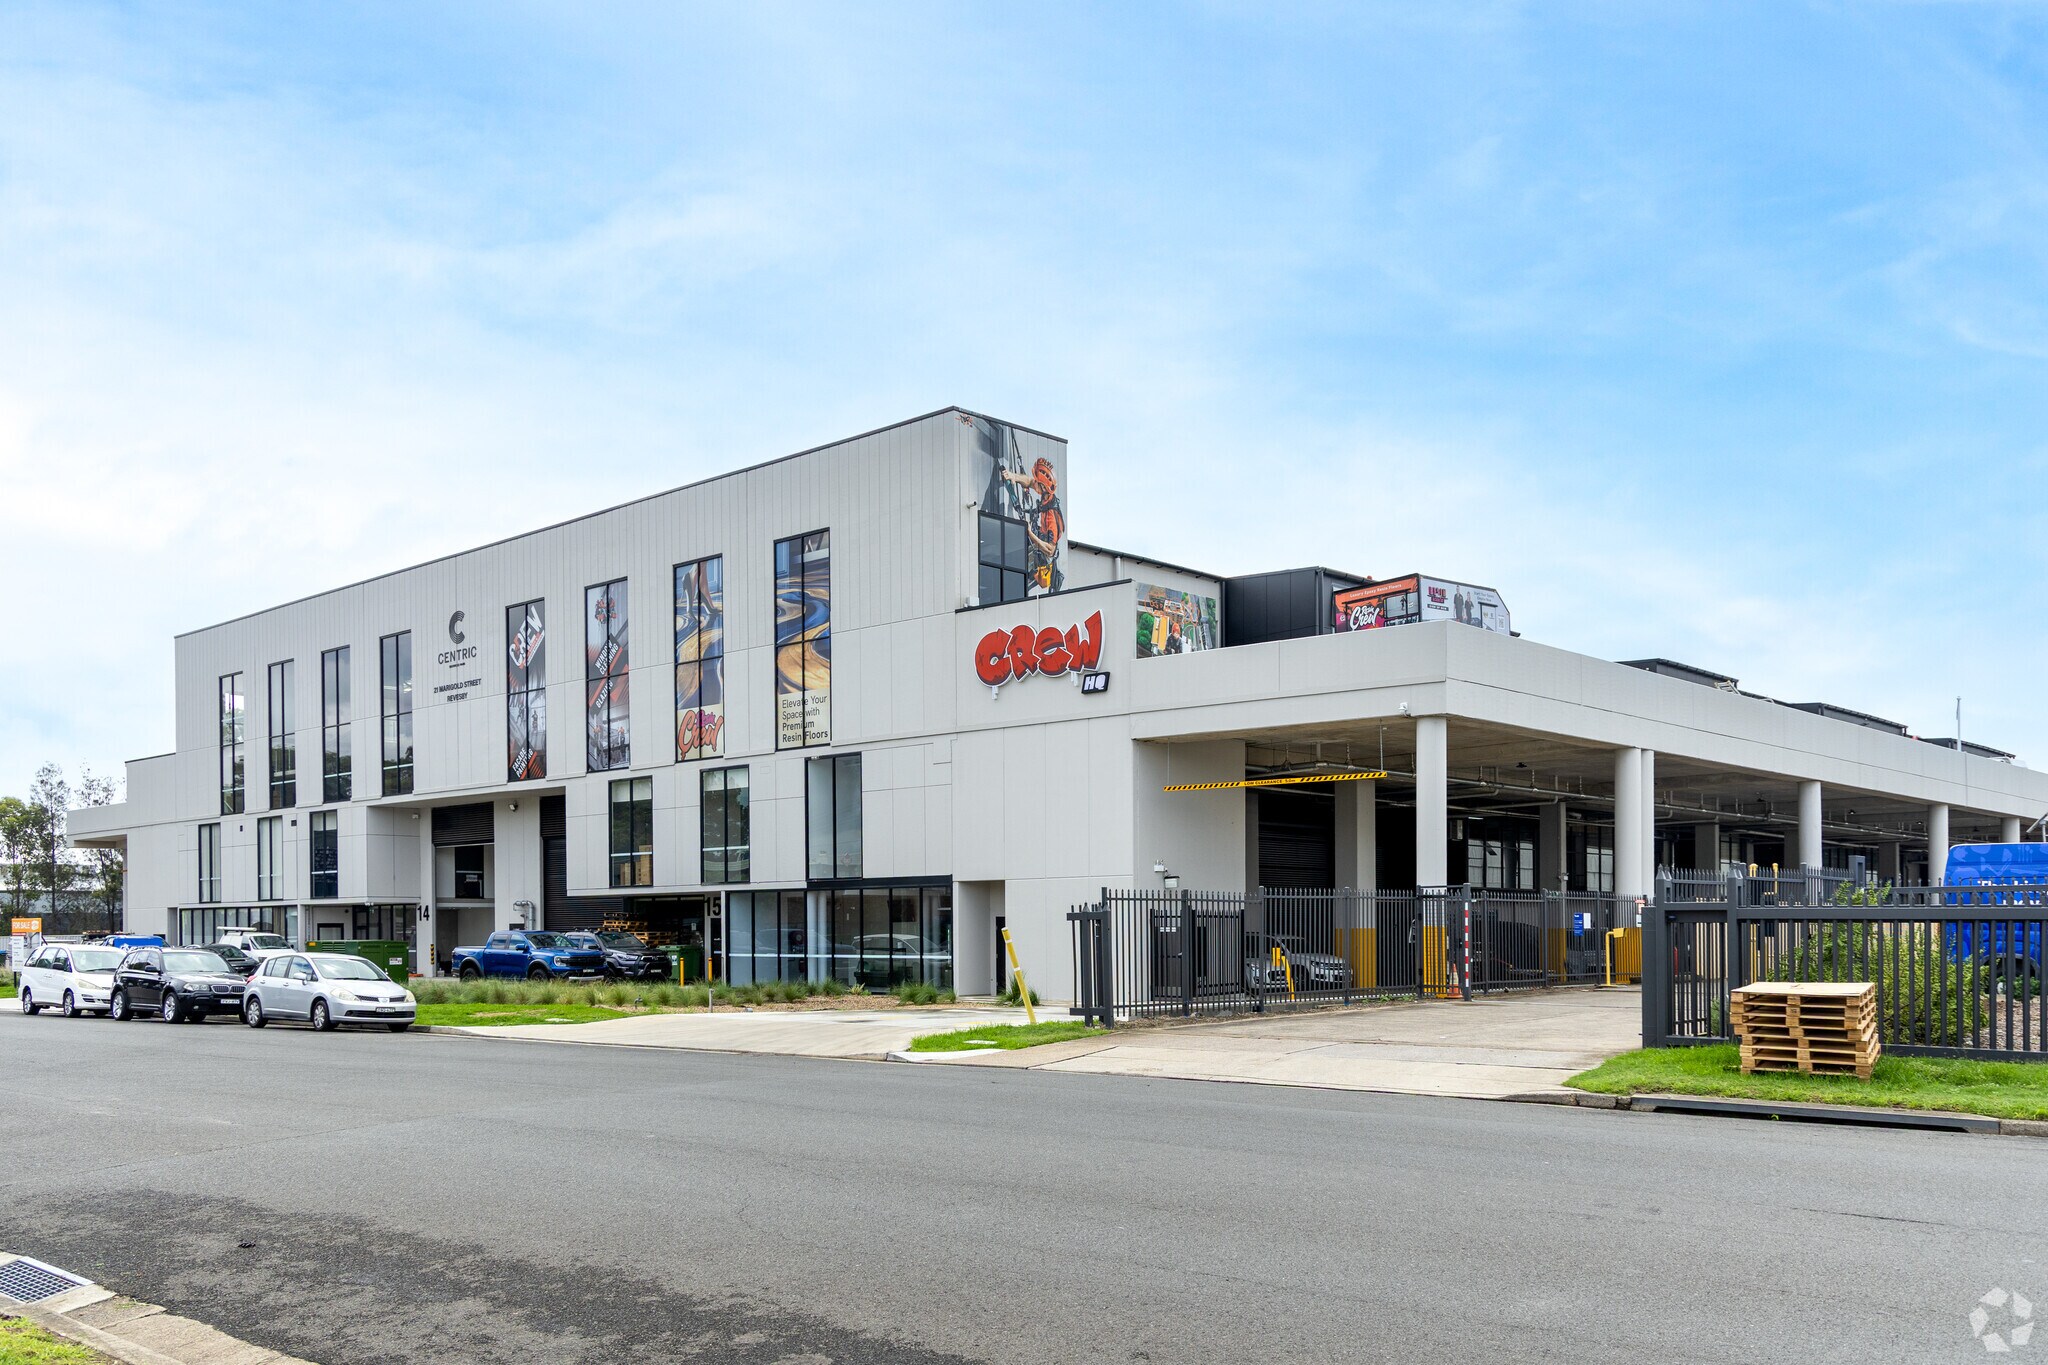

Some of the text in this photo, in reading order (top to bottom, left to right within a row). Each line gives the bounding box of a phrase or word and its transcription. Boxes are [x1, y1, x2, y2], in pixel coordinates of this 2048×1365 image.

[438, 646, 477, 664] CENTRIC
[439, 682, 463, 692] MARIGOLD
[464, 678, 481, 688] STREET
[1083, 674, 1106, 690] HQ
[447, 691, 468, 702] REVESBY
[810, 695, 828, 704] Your
[782, 707, 820, 721] Space with
[782, 721, 815, 731] Premium
[782, 730, 828, 743] Resin Floors
[417, 904, 430, 921] 14
[704, 896, 721, 916] 15
[20, 921, 30, 929] SALE
